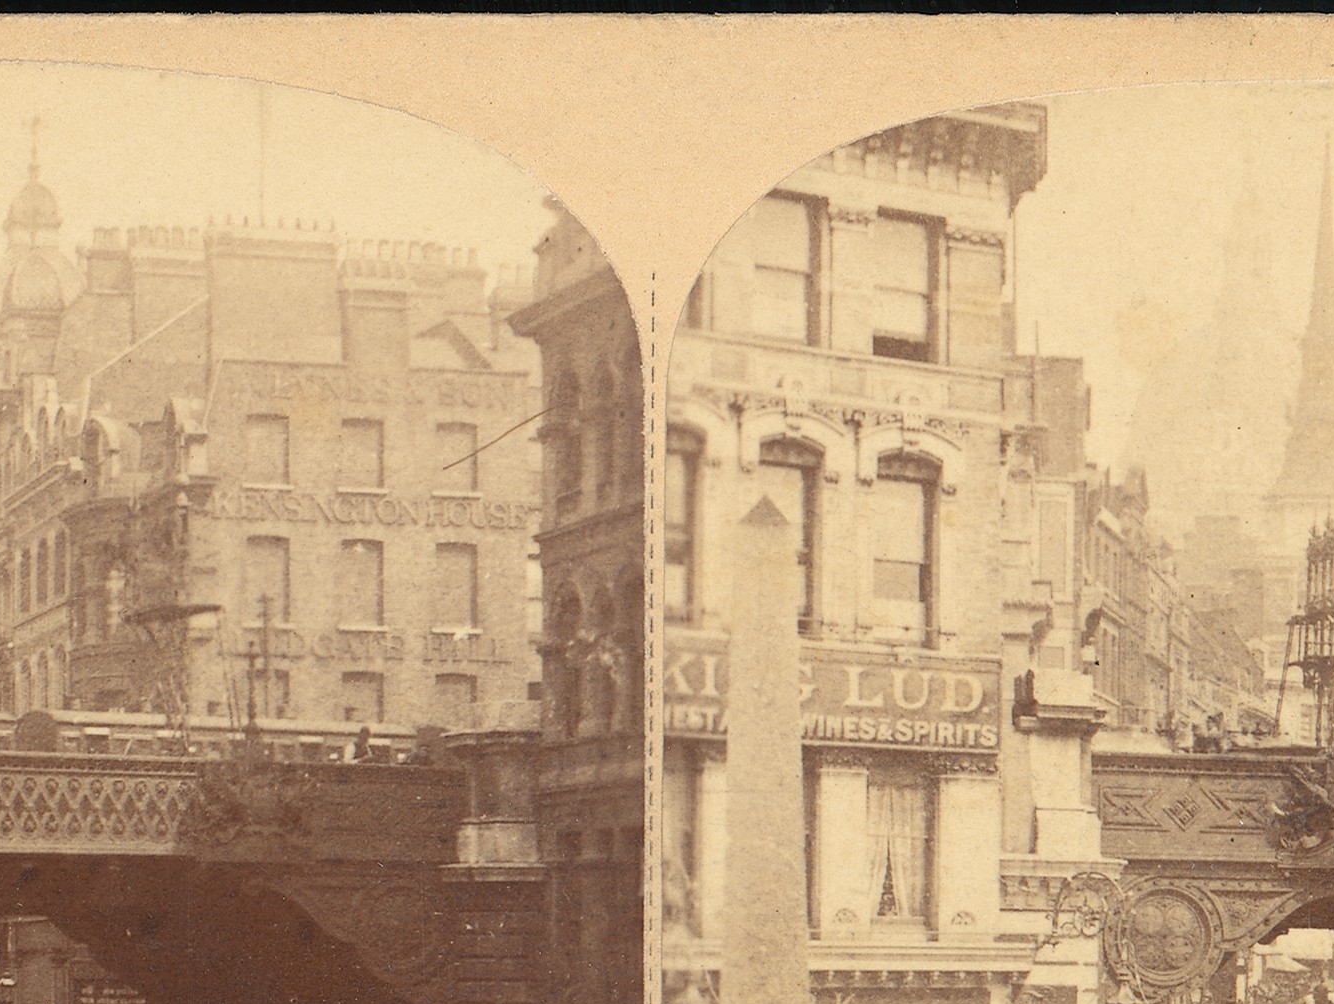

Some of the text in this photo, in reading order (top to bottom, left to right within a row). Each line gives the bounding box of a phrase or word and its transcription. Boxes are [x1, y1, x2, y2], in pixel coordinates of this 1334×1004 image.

[212, 492, 528, 530] KENSINGTON HOUSE
[843, 665, 990, 715] LUD.
